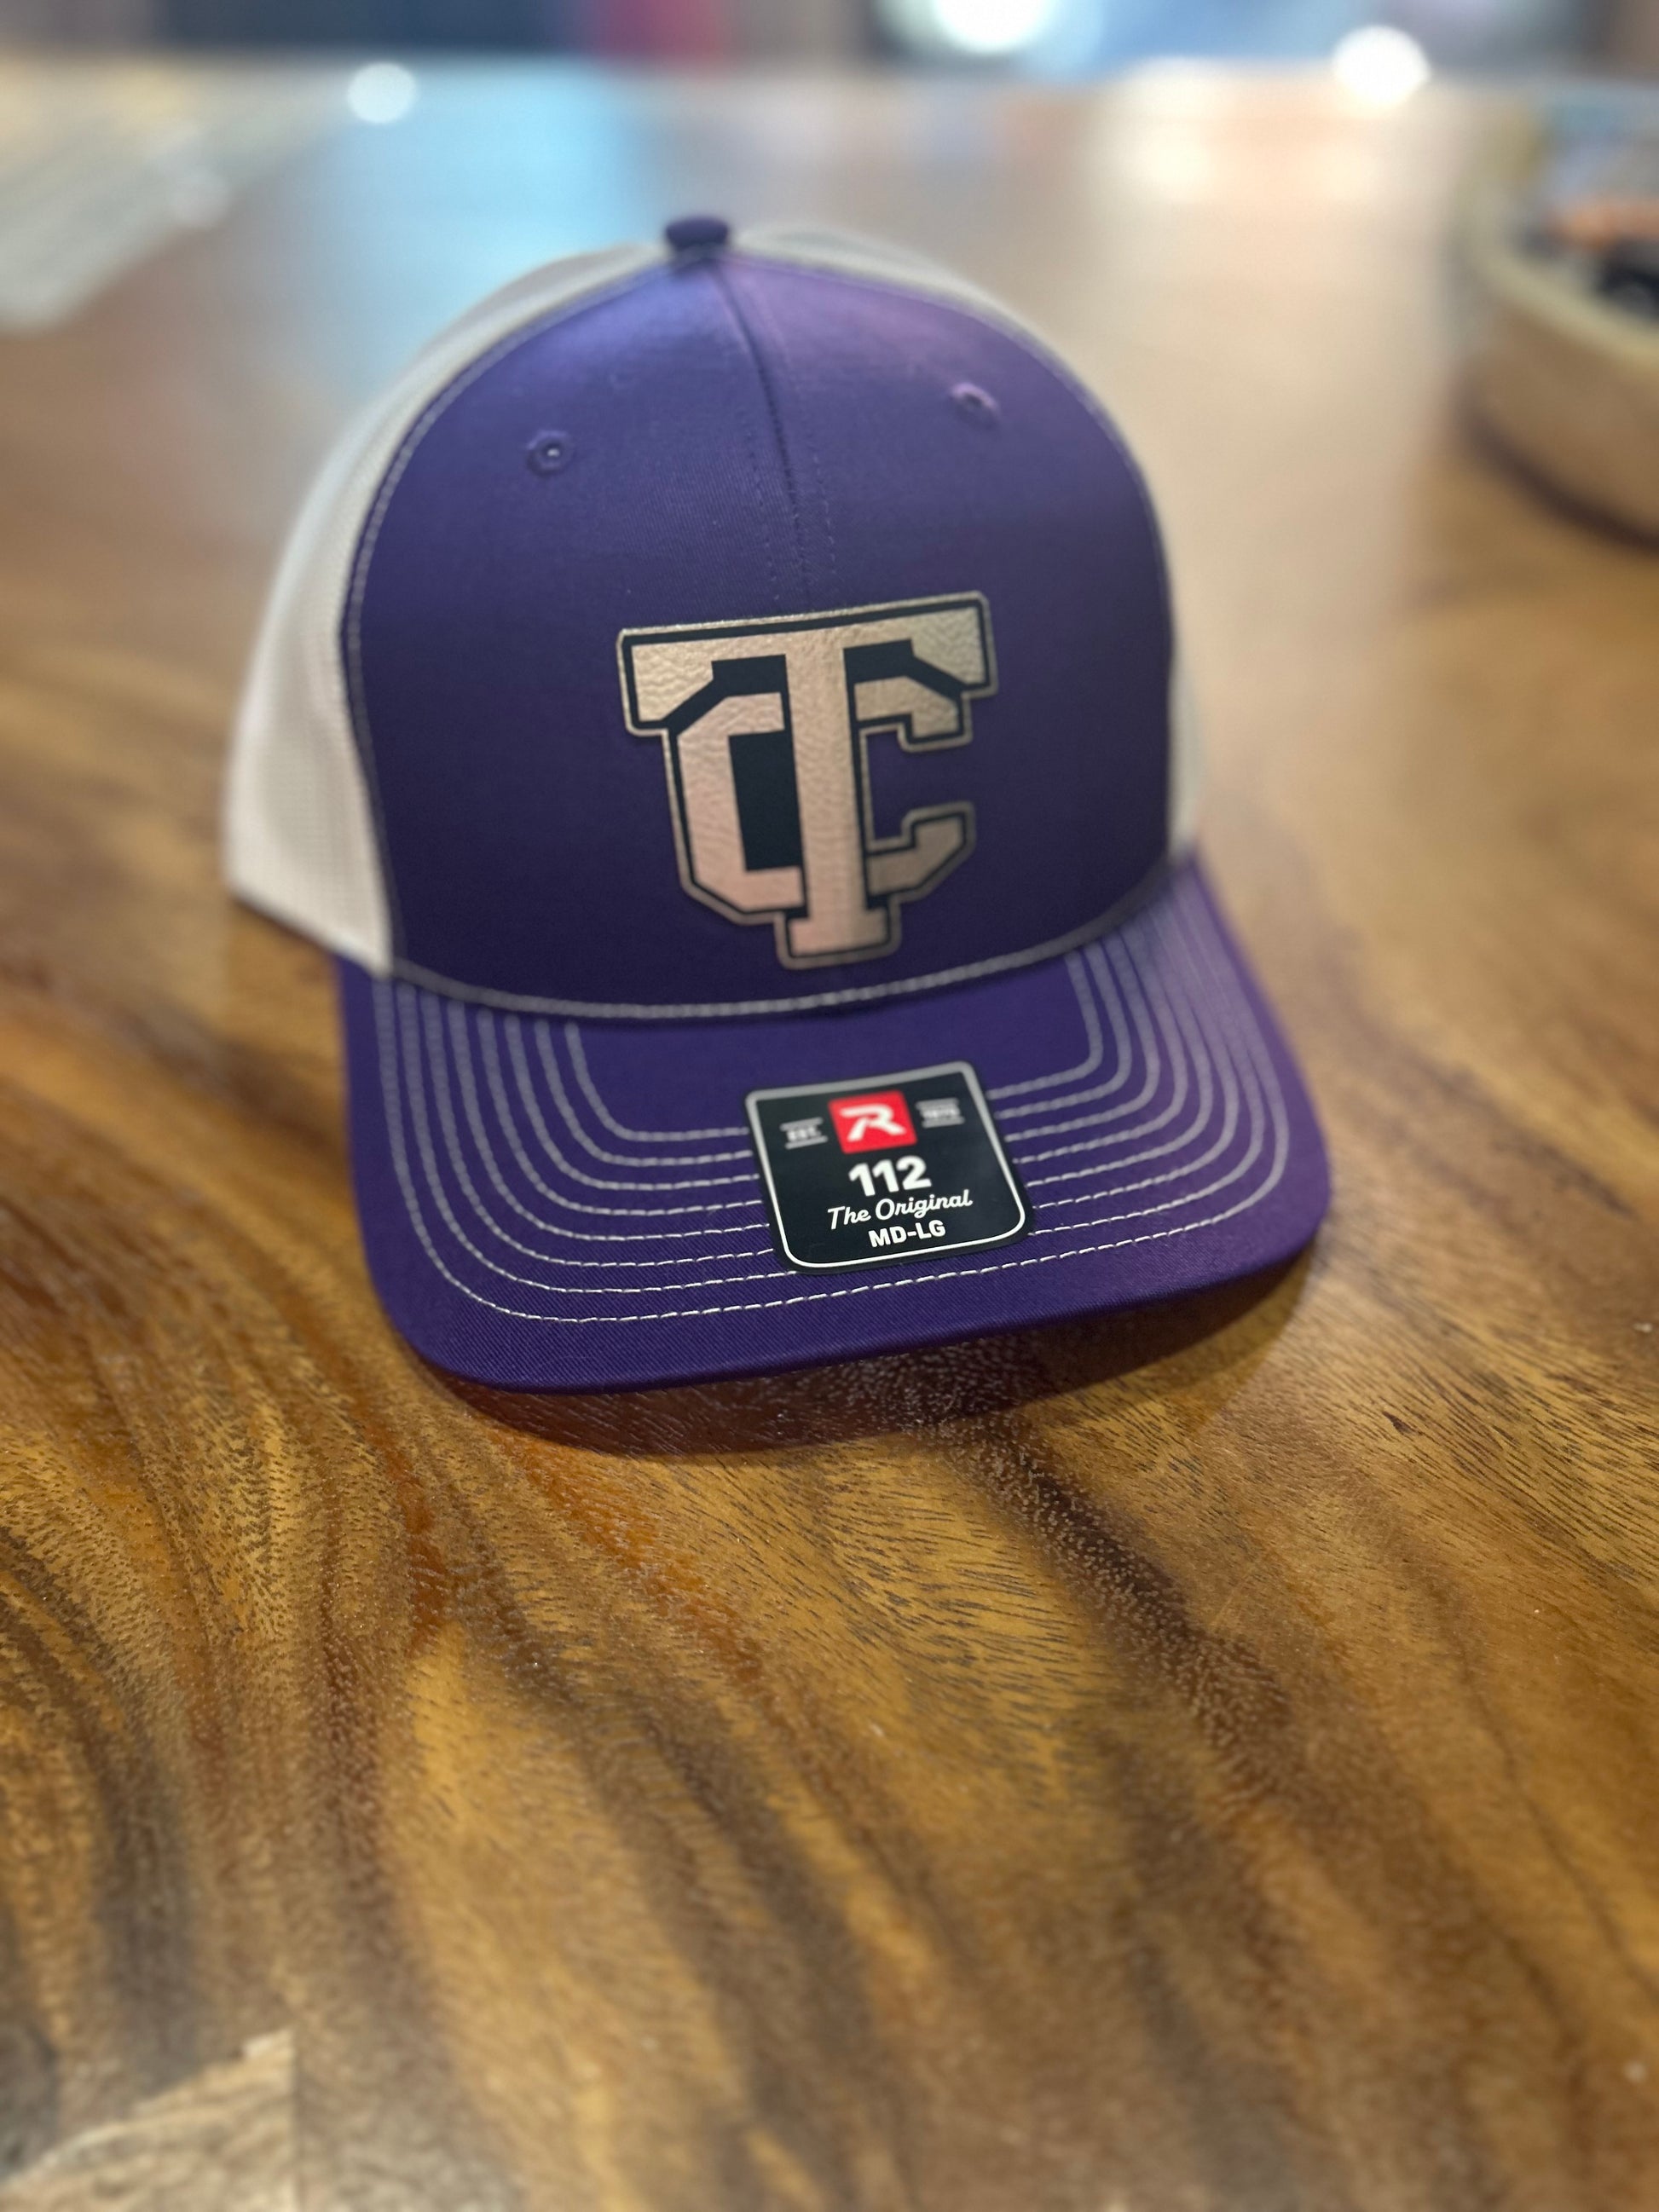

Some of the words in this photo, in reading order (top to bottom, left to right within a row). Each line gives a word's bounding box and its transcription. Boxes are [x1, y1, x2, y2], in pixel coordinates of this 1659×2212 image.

[840, 1103, 907, 1142] R
[848, 1155, 932, 1196] 112
[827, 1206, 871, 1230] The
[875, 1189, 974, 1219] Original
[868, 1220, 946, 1248] MD-LG
